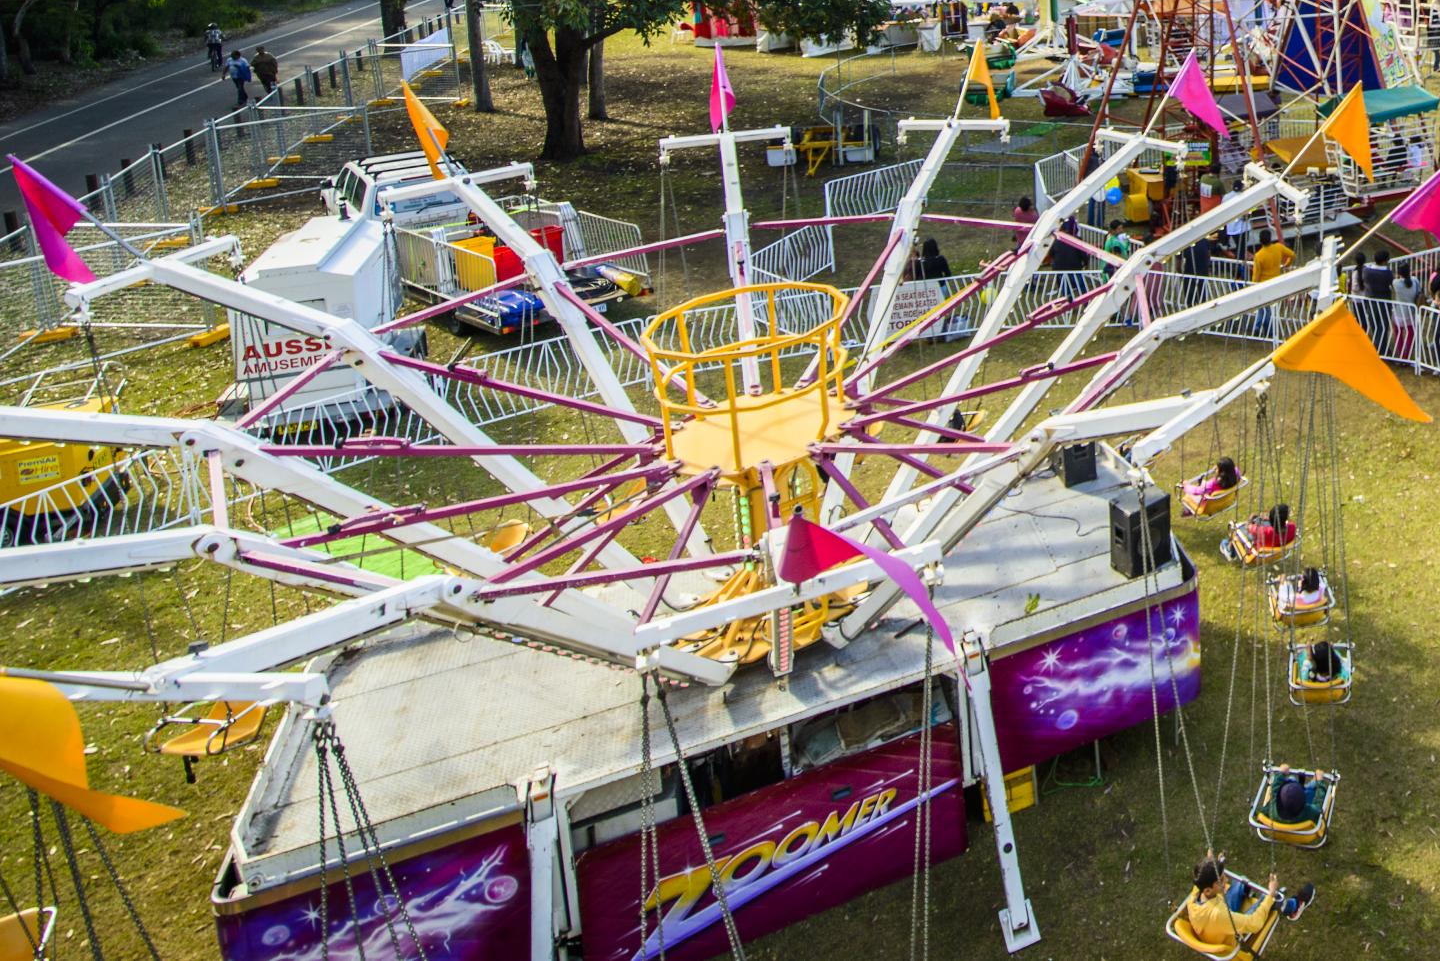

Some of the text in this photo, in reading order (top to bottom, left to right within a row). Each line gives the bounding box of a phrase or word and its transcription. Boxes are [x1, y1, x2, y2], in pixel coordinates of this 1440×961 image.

[901, 291, 917, 300] SEAT
[918, 289, 937, 299] BELTS
[915, 299, 938, 307] SEATED
[903, 310, 917, 318] RIDE
[634, 787, 898, 947] ZOOMER
